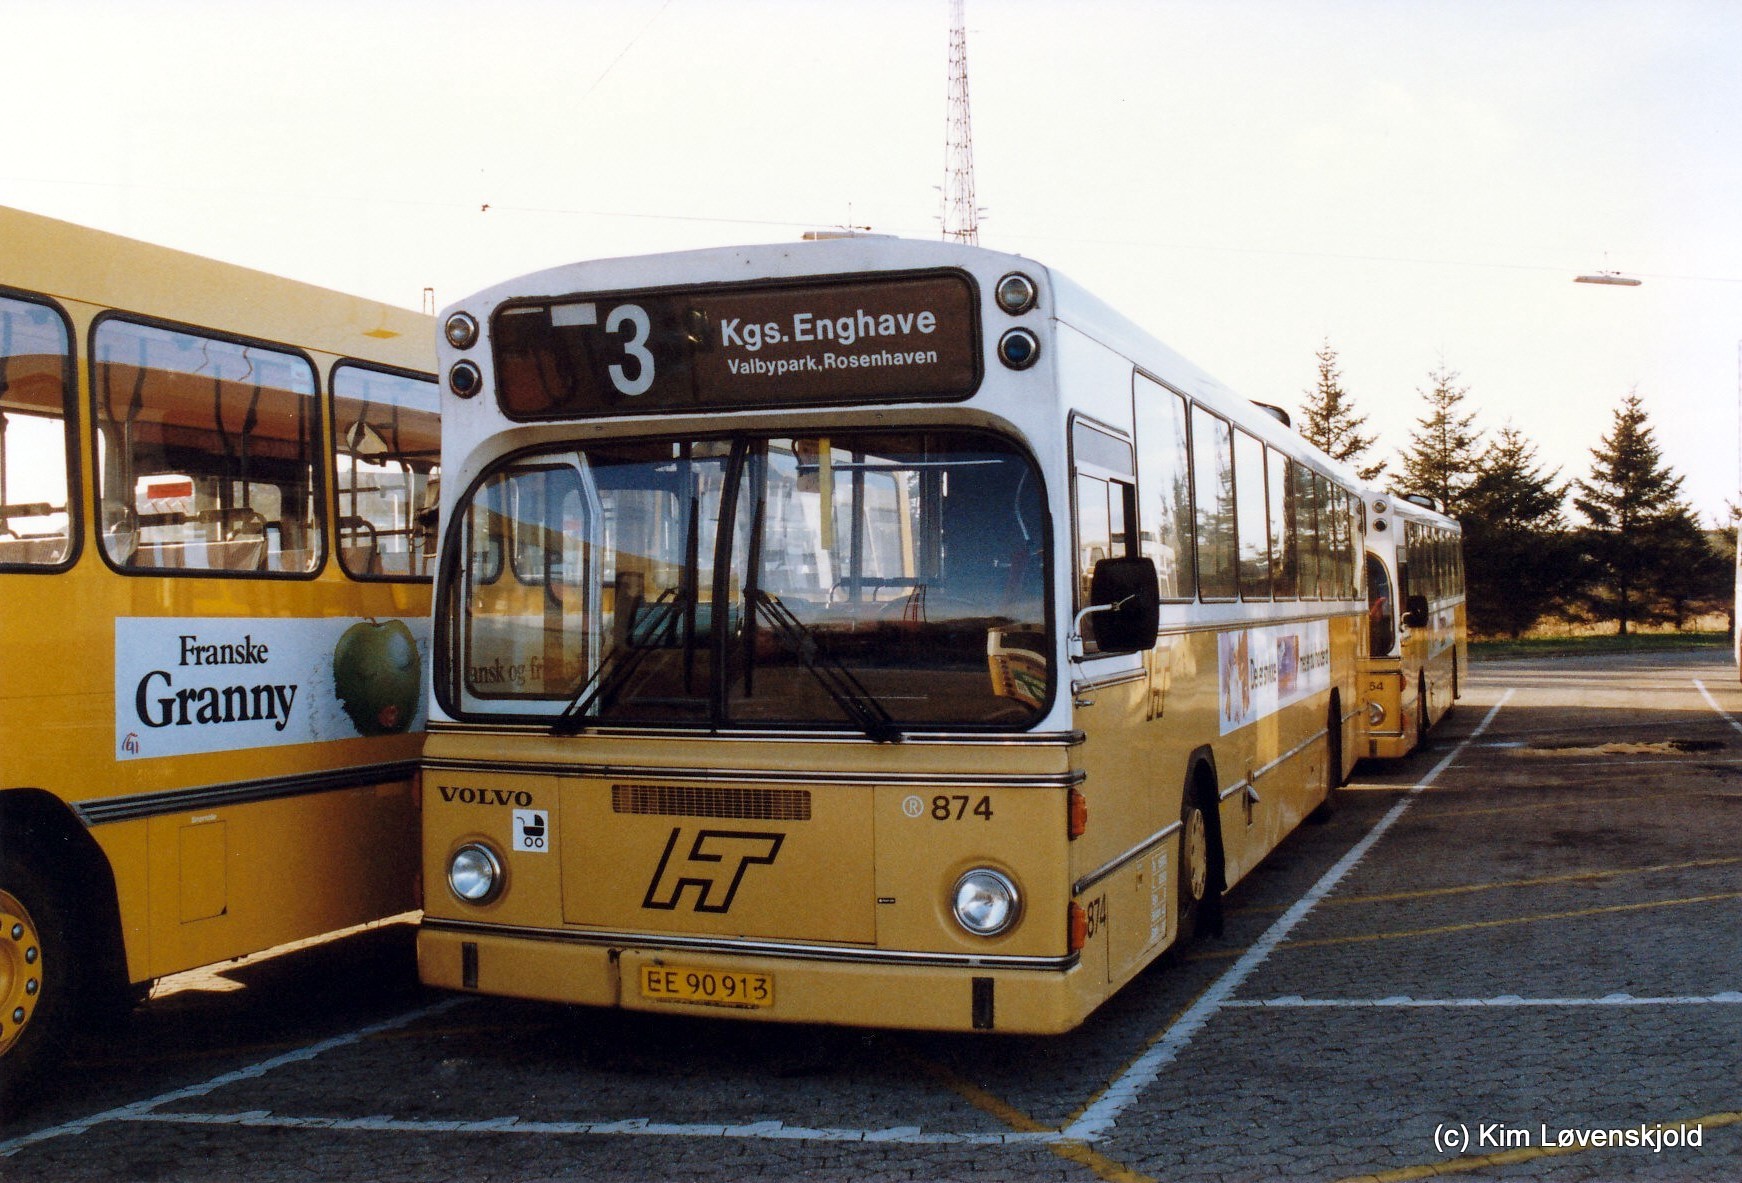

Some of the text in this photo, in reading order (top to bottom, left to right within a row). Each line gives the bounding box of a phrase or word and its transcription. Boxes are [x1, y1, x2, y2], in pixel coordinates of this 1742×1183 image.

[720, 309, 937, 350] Kgs. Enghave
[605, 303, 655, 396] 3
[178, 634, 269, 666] Franske
[468, 656, 506, 684] ansk
[135, 670, 298, 732] Granny
[437, 786, 533, 807] VOLVO
[931, 795, 994, 821] 874
[1087, 892, 1107, 939] 874
[647, 970, 679, 993] EE
